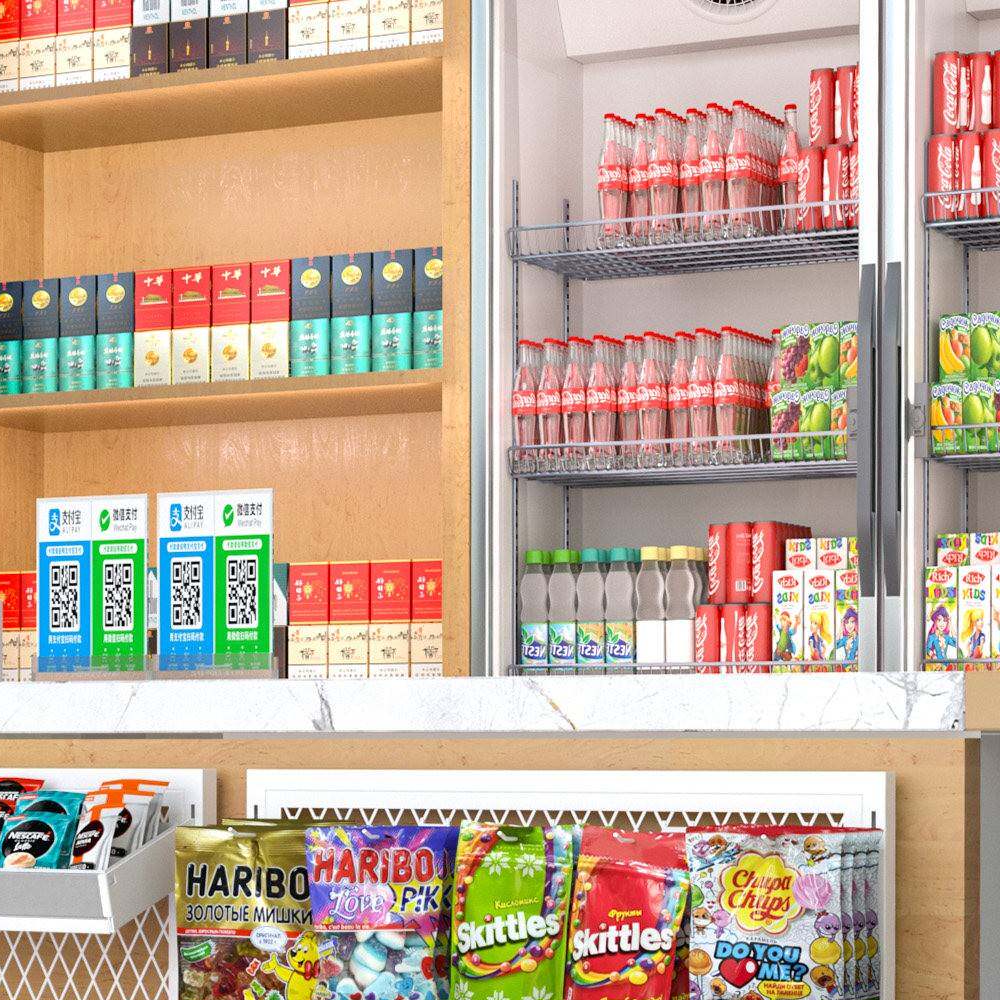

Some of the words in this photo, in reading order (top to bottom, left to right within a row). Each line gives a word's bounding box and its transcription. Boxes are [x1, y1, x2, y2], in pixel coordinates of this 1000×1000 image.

[62, 510, 81, 525] 支付宝
[112, 508, 138, 521] 微信支付
[184, 505, 204, 520] 支付宝
[236, 502, 262, 516] 微信支付
[313, 848, 434, 884] HARIBO
[186, 863, 309, 901] HARIBO
[731, 869, 792, 891] Chupa
[729, 890, 791, 912] Chups
[185, 904, 250, 922] ЗОЛОТЫЕ
[253, 906, 312, 925] МИШКИ
[457, 911, 560, 953] Skittles
[573, 922, 674, 960] Skittles
[714, 940, 750, 959] DO
[751, 942, 801, 962] YOU
[757, 962, 809, 981] ME?
